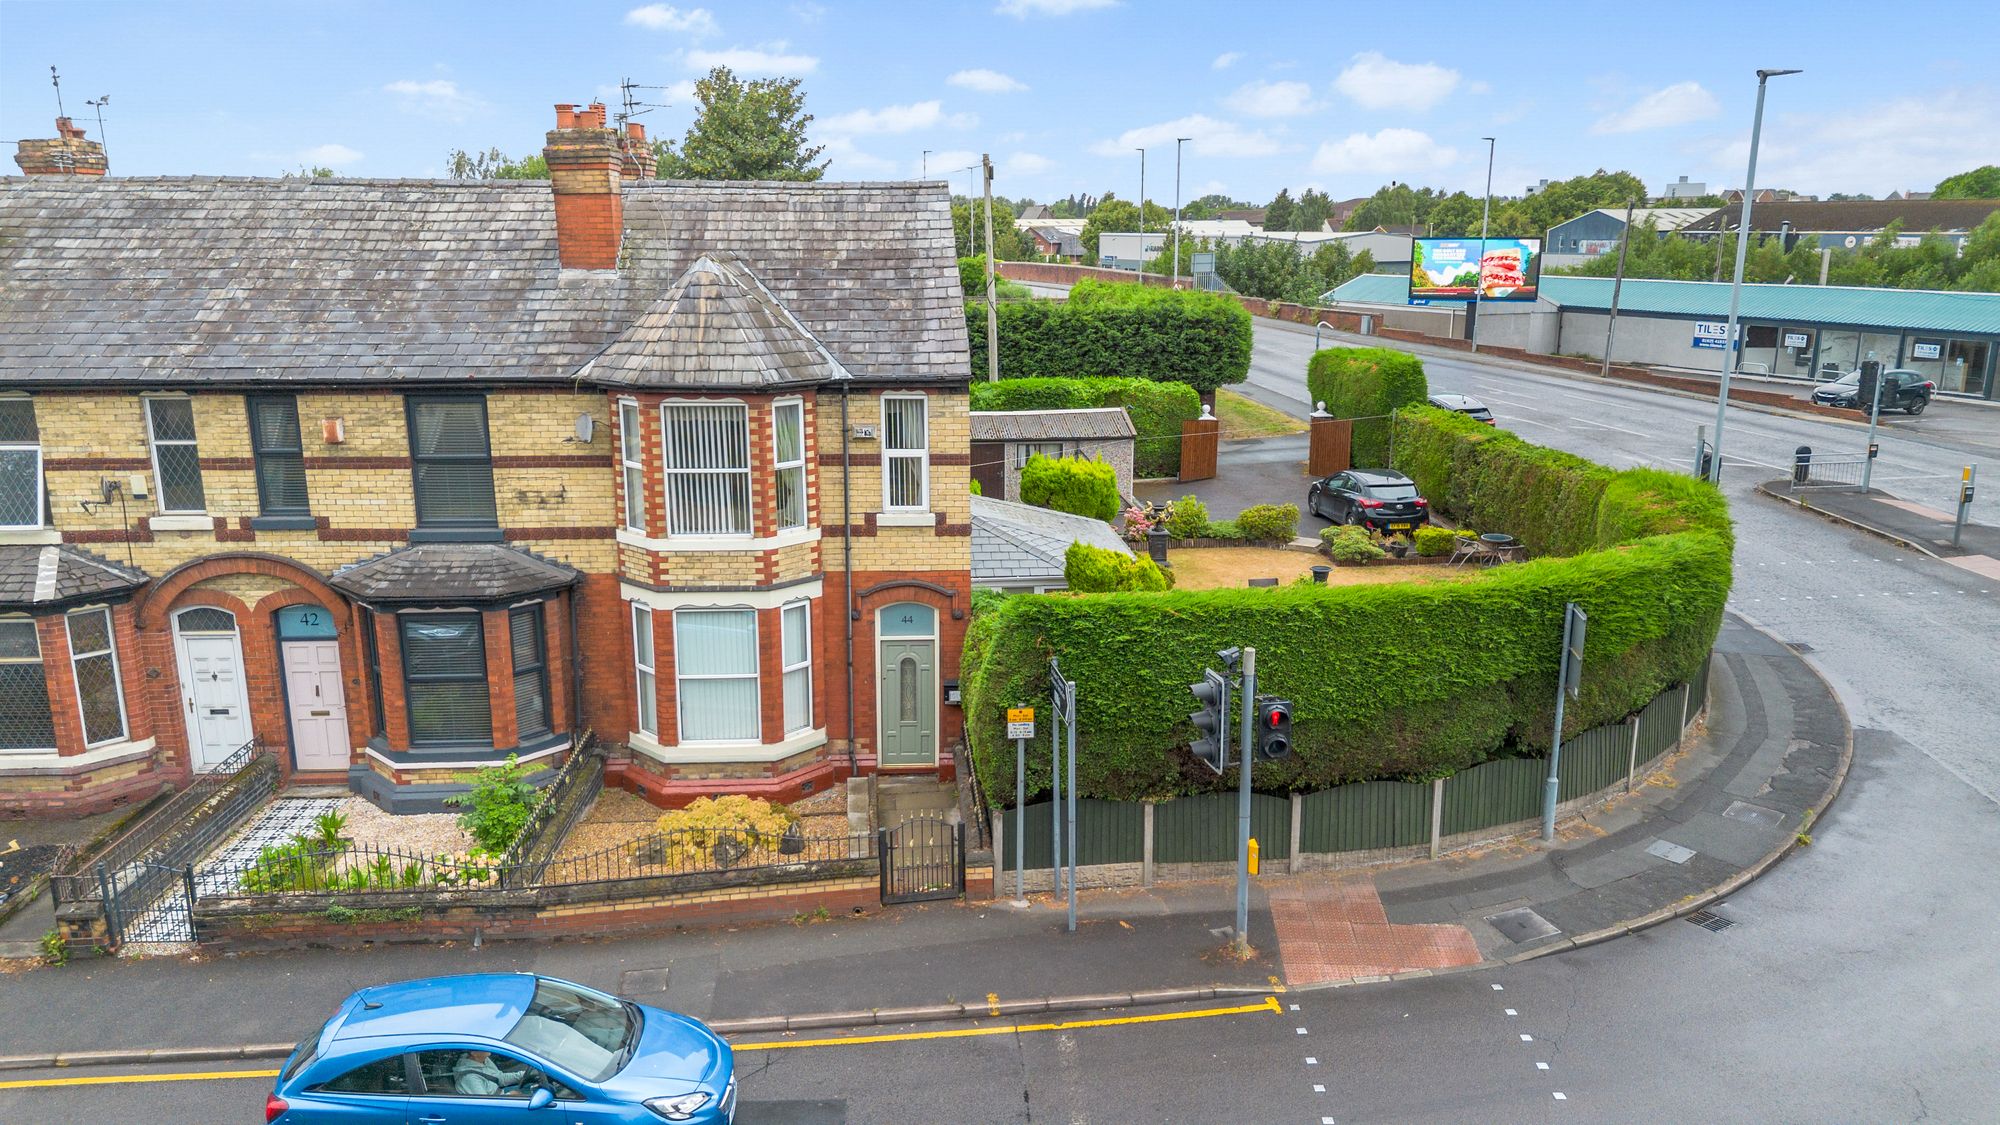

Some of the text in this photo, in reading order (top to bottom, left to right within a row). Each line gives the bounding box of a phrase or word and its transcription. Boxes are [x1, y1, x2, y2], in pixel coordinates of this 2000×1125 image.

[1697, 323, 1727, 335] TILES
[300, 612, 319, 626] 42
[901, 615, 914, 624] 44
